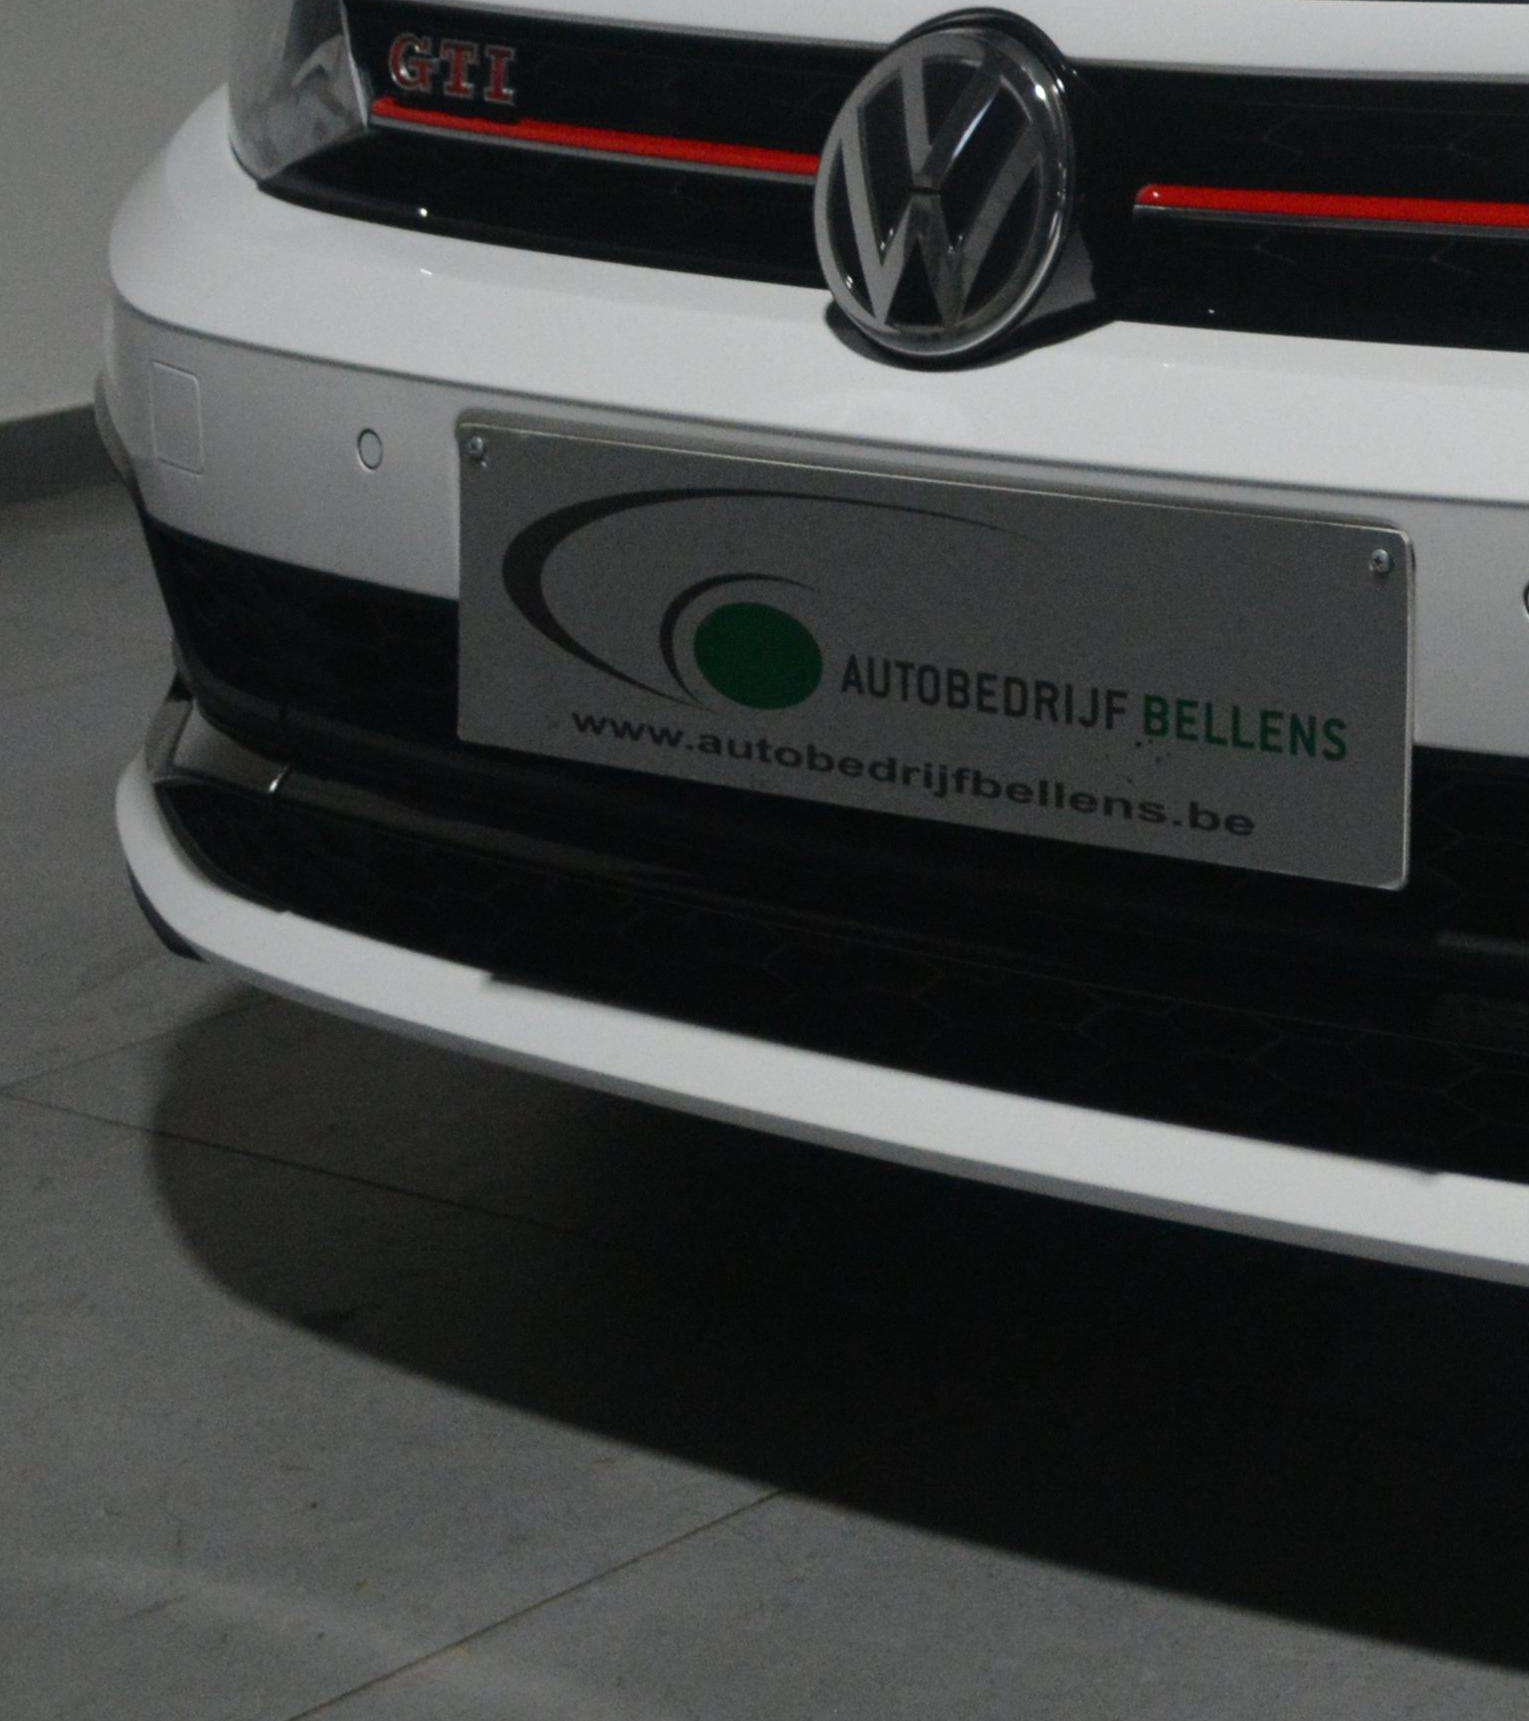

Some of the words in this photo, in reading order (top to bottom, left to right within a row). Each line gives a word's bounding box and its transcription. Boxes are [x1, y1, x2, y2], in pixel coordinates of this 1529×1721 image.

[387, 31, 517, 107] GTI
[840, 652, 1130, 732] AUTOBEDRIJF
[1142, 691, 1349, 763] BELLENS
[570, 710, 1256, 838] www.autobedrijfbellens.be
